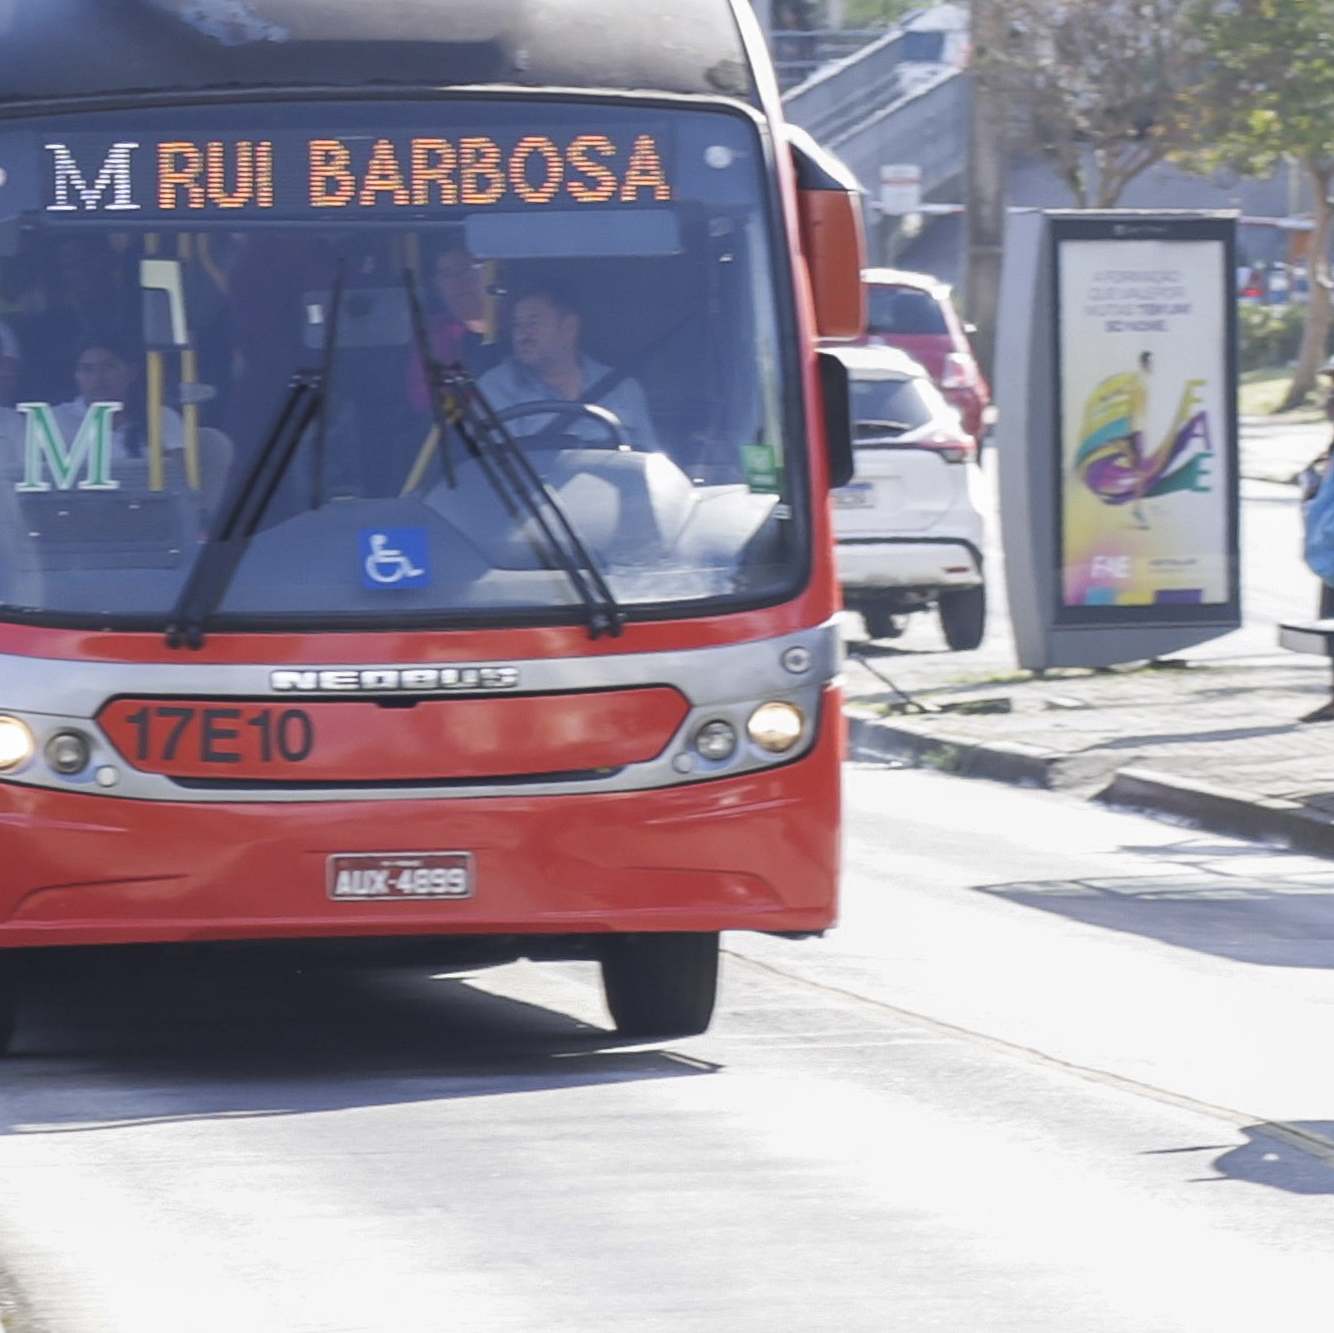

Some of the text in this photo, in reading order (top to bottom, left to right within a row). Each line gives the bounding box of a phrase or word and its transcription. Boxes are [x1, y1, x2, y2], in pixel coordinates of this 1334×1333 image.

[46, 134, 672, 210] M RUI BARBOSA
[15, 401, 124, 492] M
[270, 668, 520, 692] NEOBUS
[125, 706, 314, 763] 17E10
